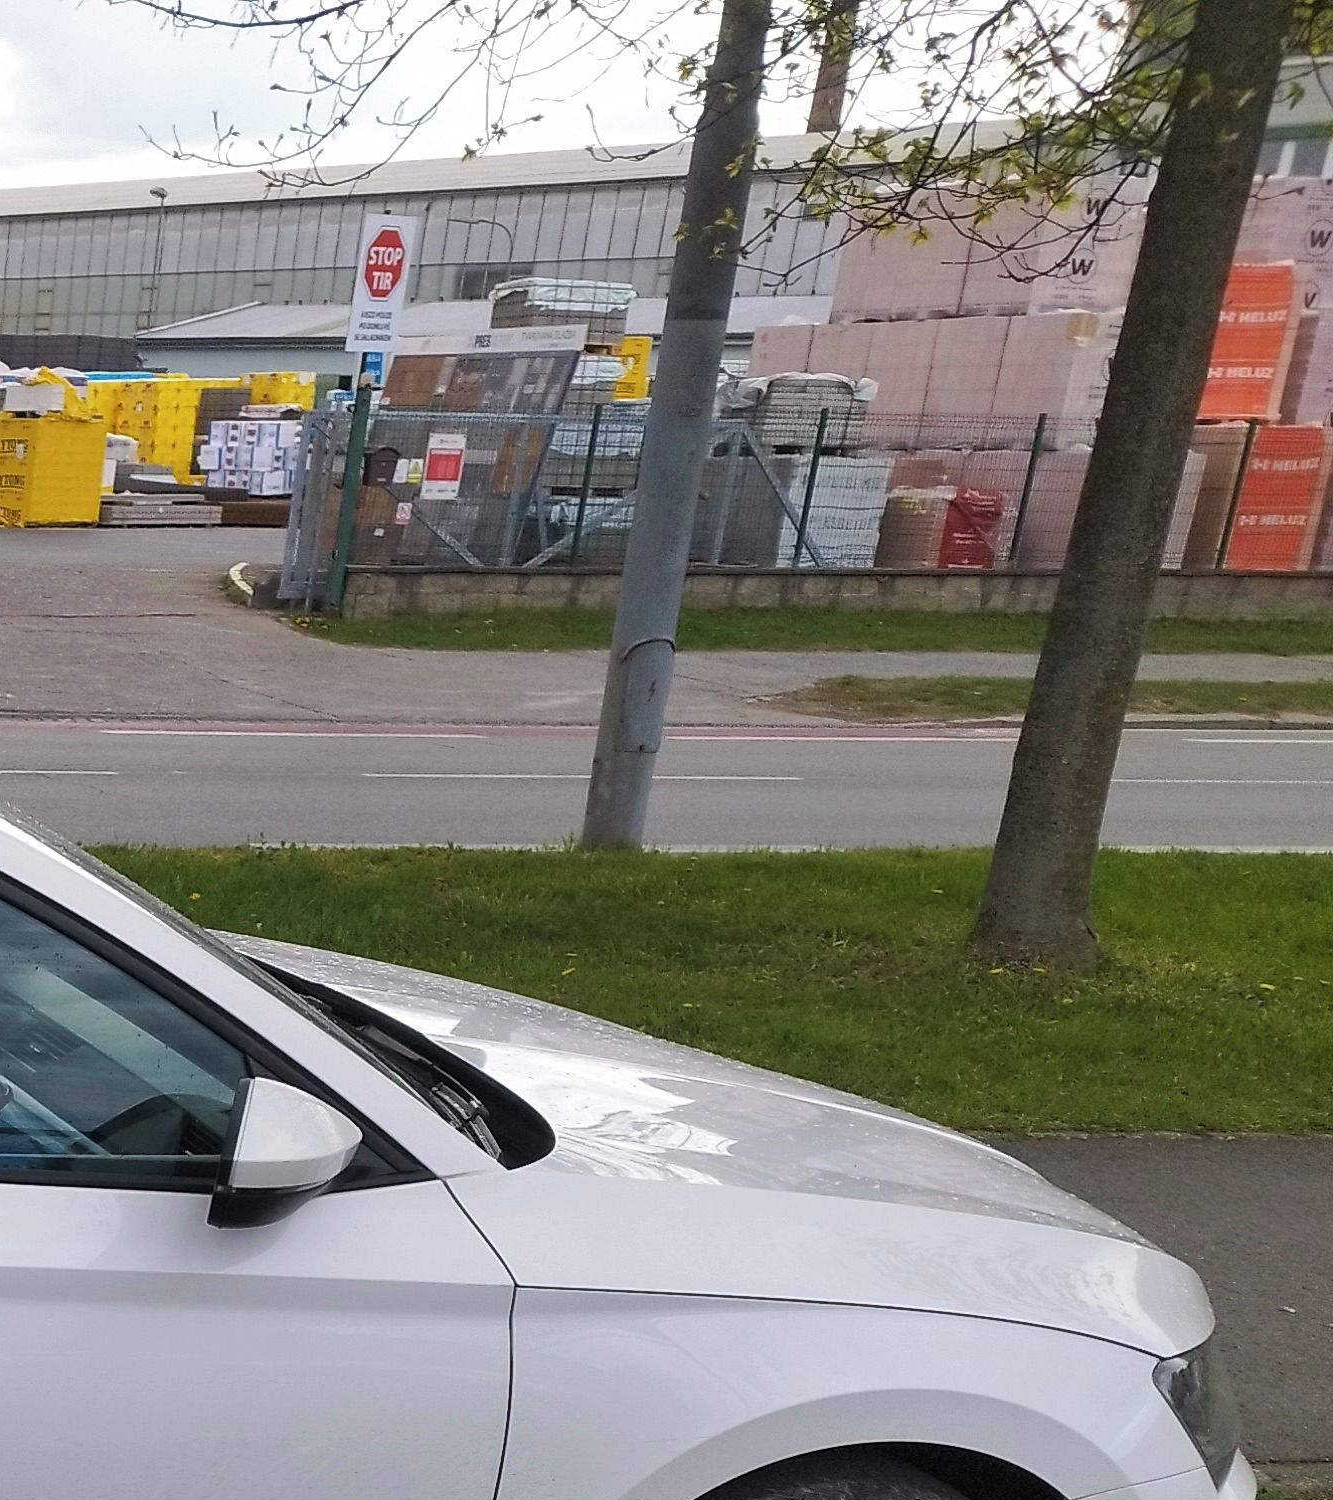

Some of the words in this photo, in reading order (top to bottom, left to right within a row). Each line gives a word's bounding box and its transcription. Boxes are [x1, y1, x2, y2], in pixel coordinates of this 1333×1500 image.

[368, 246, 403, 266] STOP
[372, 271, 394, 291] TIR
[1239, 309, 1287, 323] HELUZ
[1226, 367, 1275, 380] HELUZ
[1272, 457, 1320, 471] HELUZ
[1259, 514, 1307, 526] HELUZ
